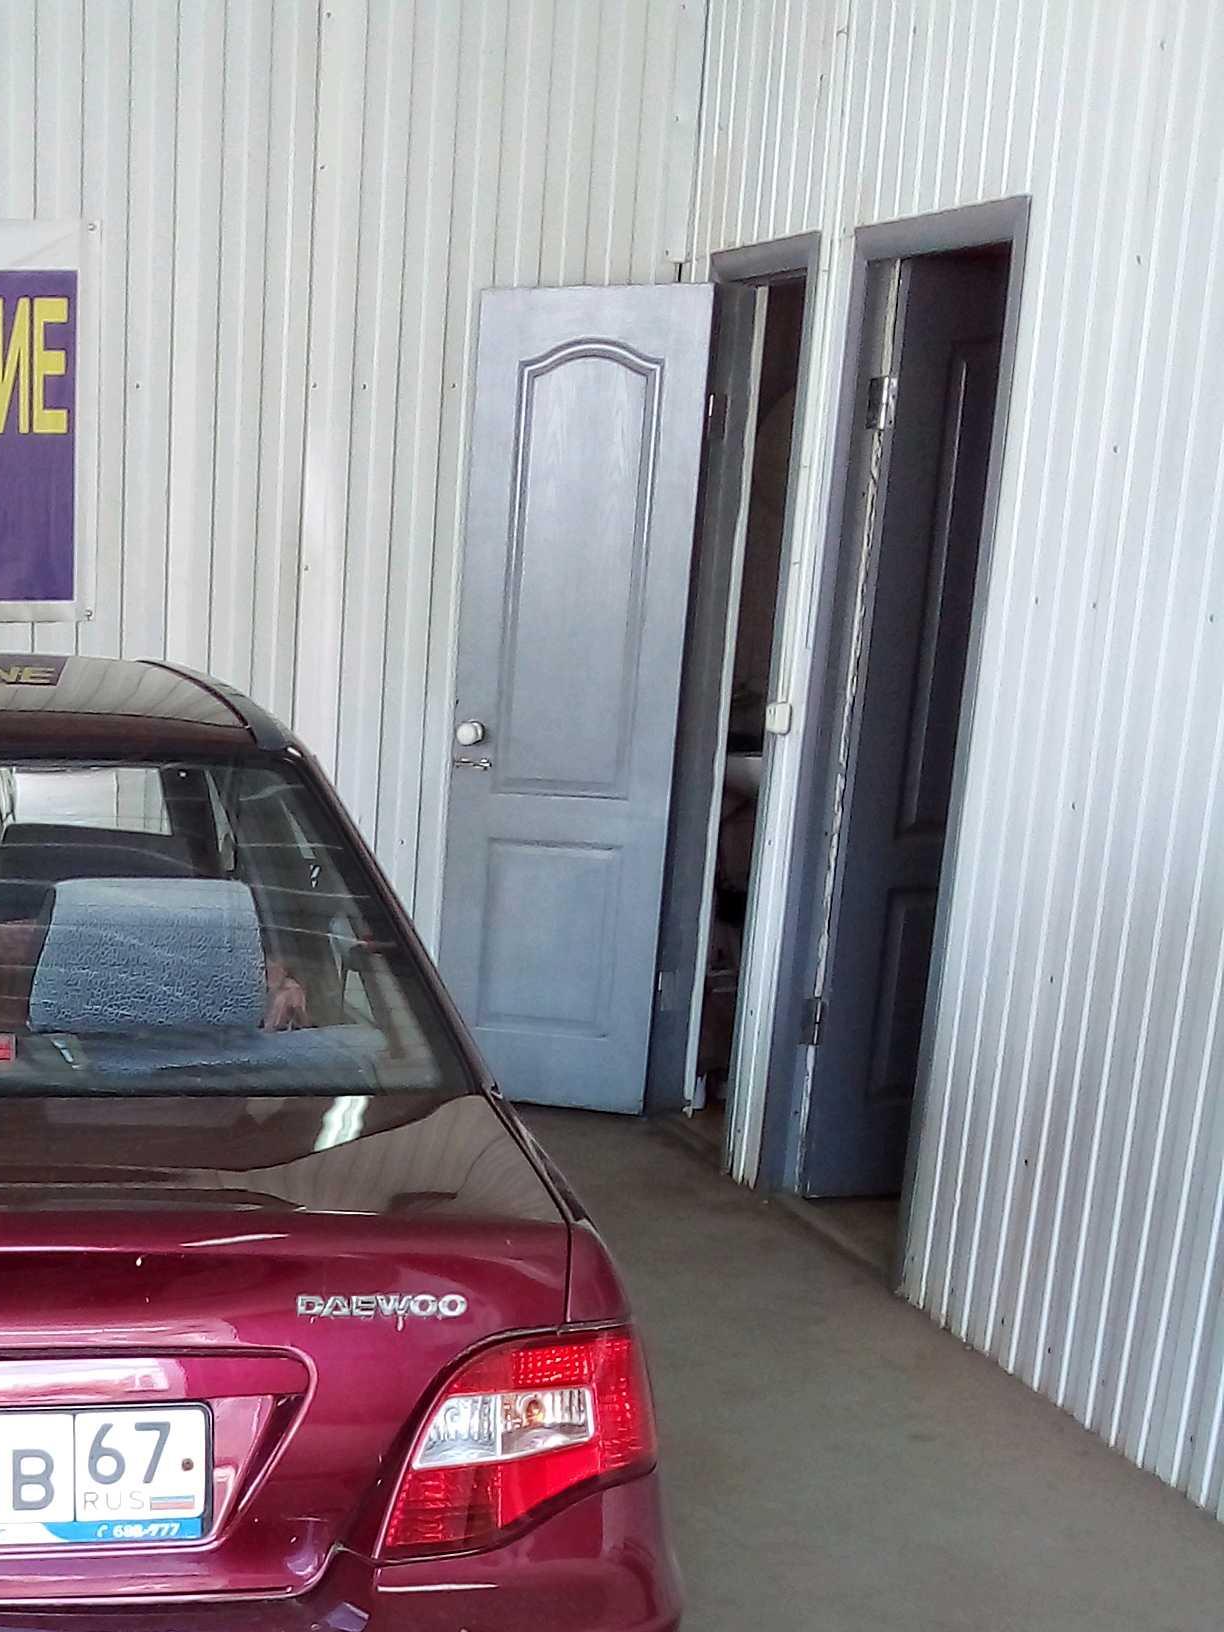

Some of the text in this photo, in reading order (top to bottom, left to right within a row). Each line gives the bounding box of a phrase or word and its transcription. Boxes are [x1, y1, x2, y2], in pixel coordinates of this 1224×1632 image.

[297, 1293, 468, 1318] DAEWOO
[87, 1421, 171, 1485] 67
[83, 1490, 145, 1512] RUS
